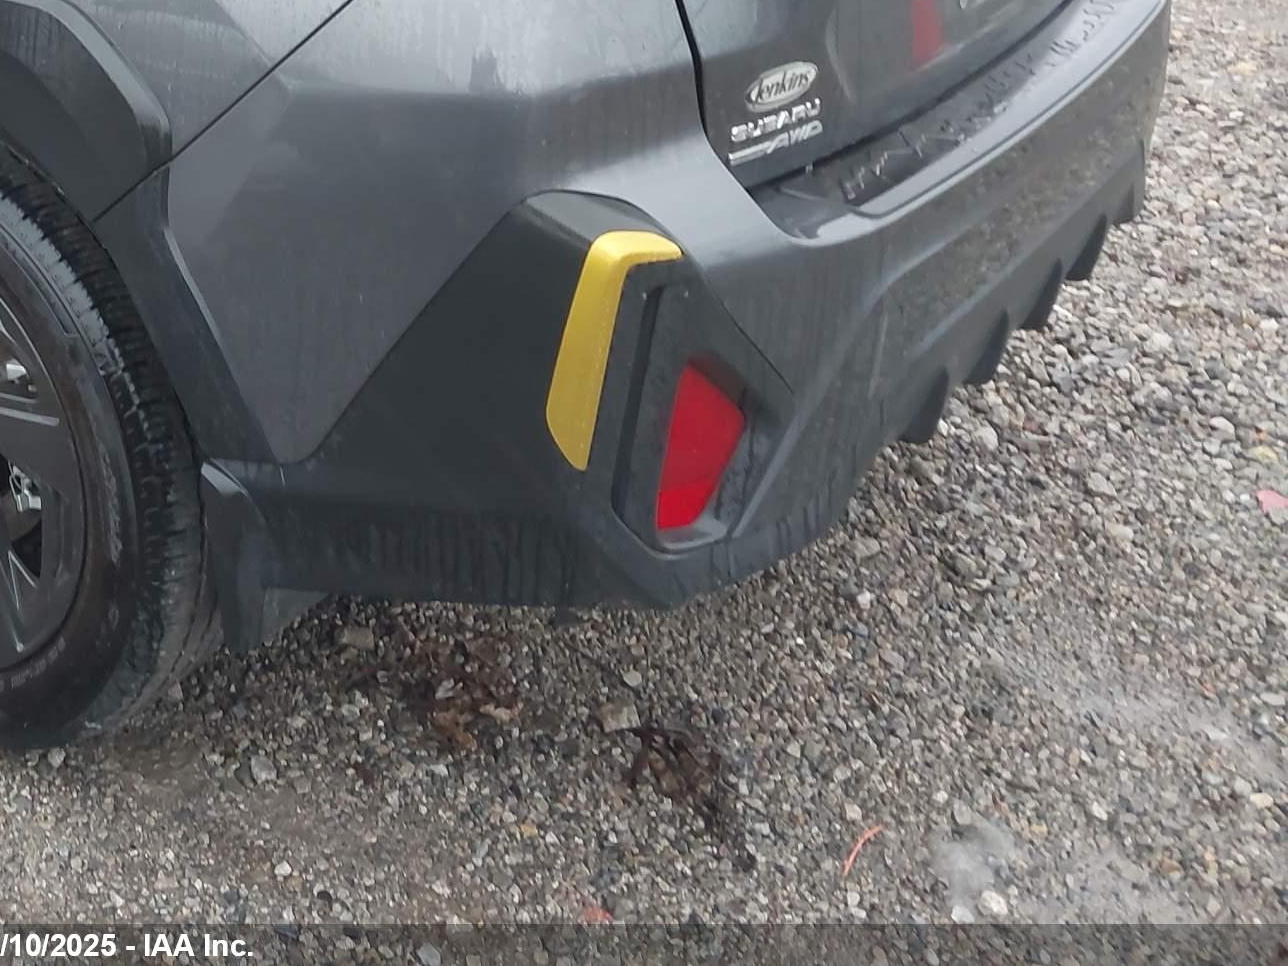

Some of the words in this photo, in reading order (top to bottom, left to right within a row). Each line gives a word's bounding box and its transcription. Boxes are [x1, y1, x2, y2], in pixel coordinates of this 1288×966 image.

[748, 70, 811, 105] Jenkins
[730, 97, 821, 142] SUBARU
[765, 120, 823, 154] AWD
